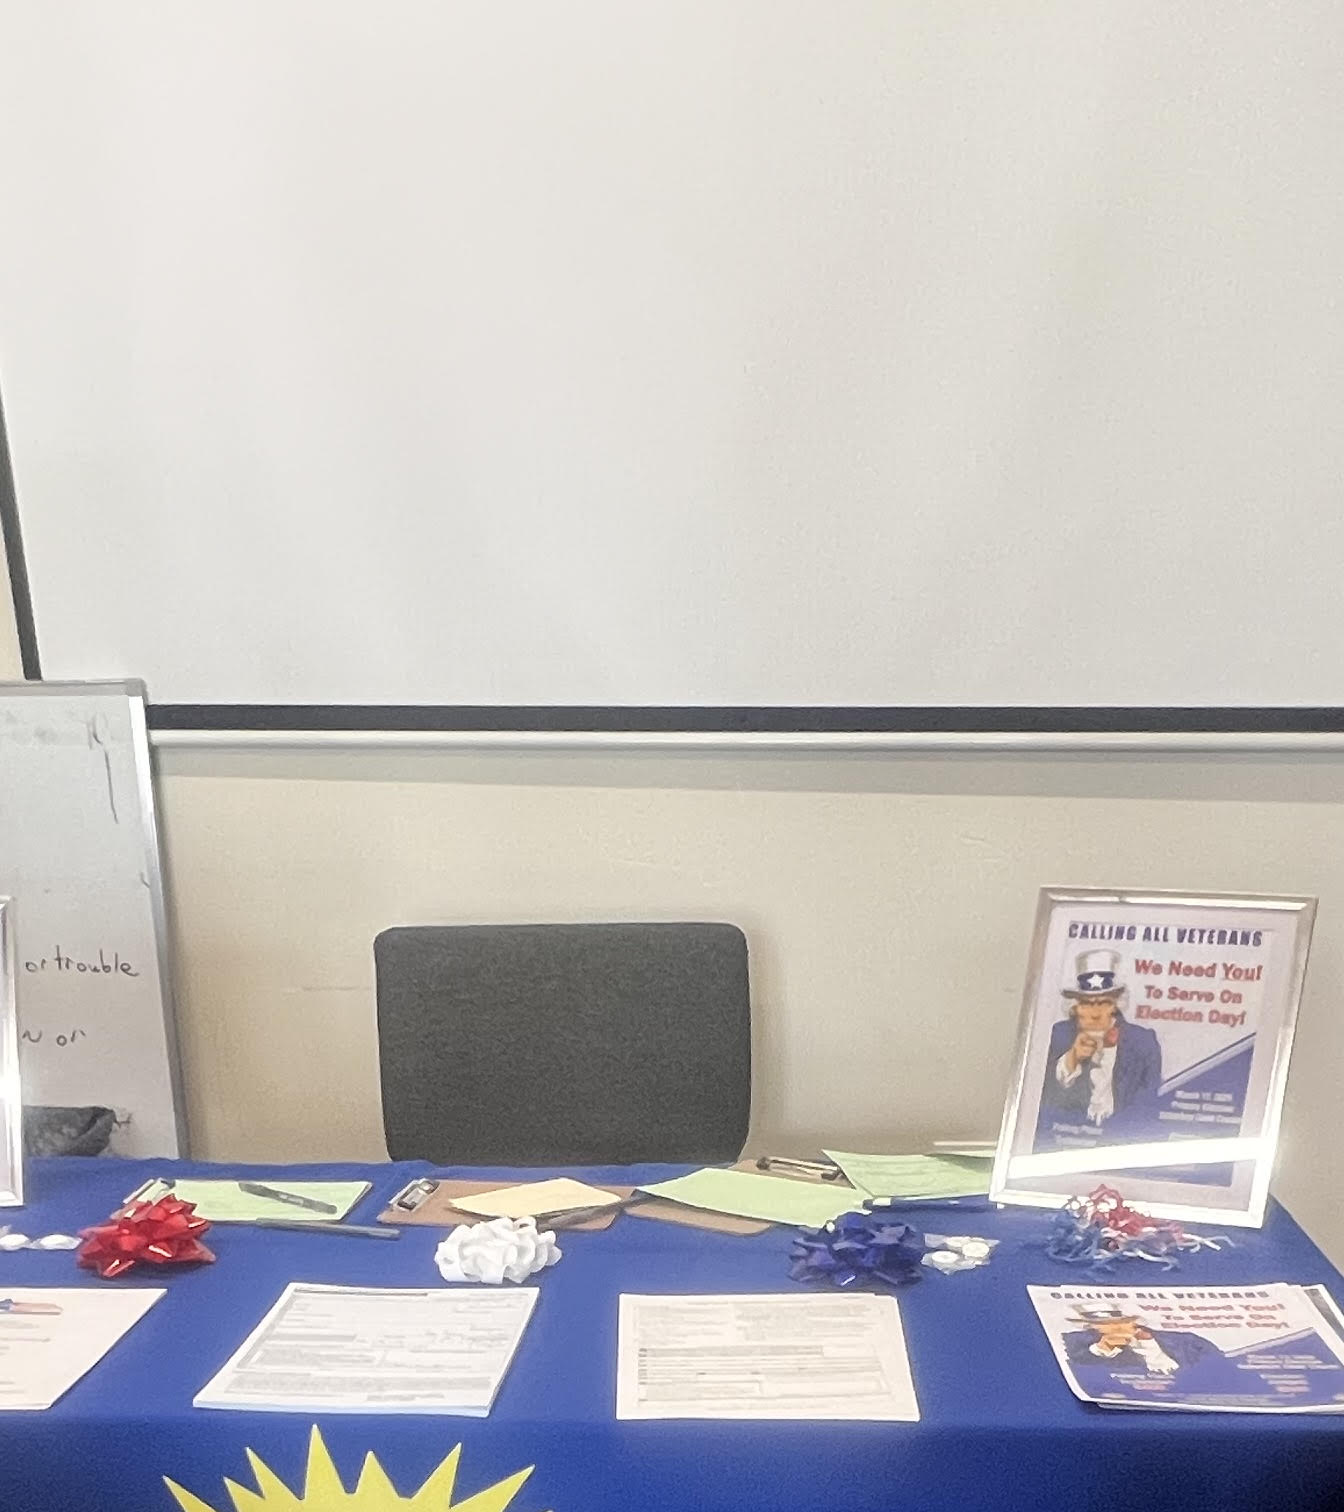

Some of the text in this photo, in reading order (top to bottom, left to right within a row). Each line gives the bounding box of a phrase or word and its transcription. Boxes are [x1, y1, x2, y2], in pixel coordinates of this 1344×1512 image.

[1068, 923, 1263, 947] CALLING ALL VETERANS
[55, 944, 140, 977] trouble
[1134, 958, 1264, 982] We Need You!
[1143, 984, 1243, 1005] To Serve On
[1135, 1004, 1247, 1029] Election Day!
